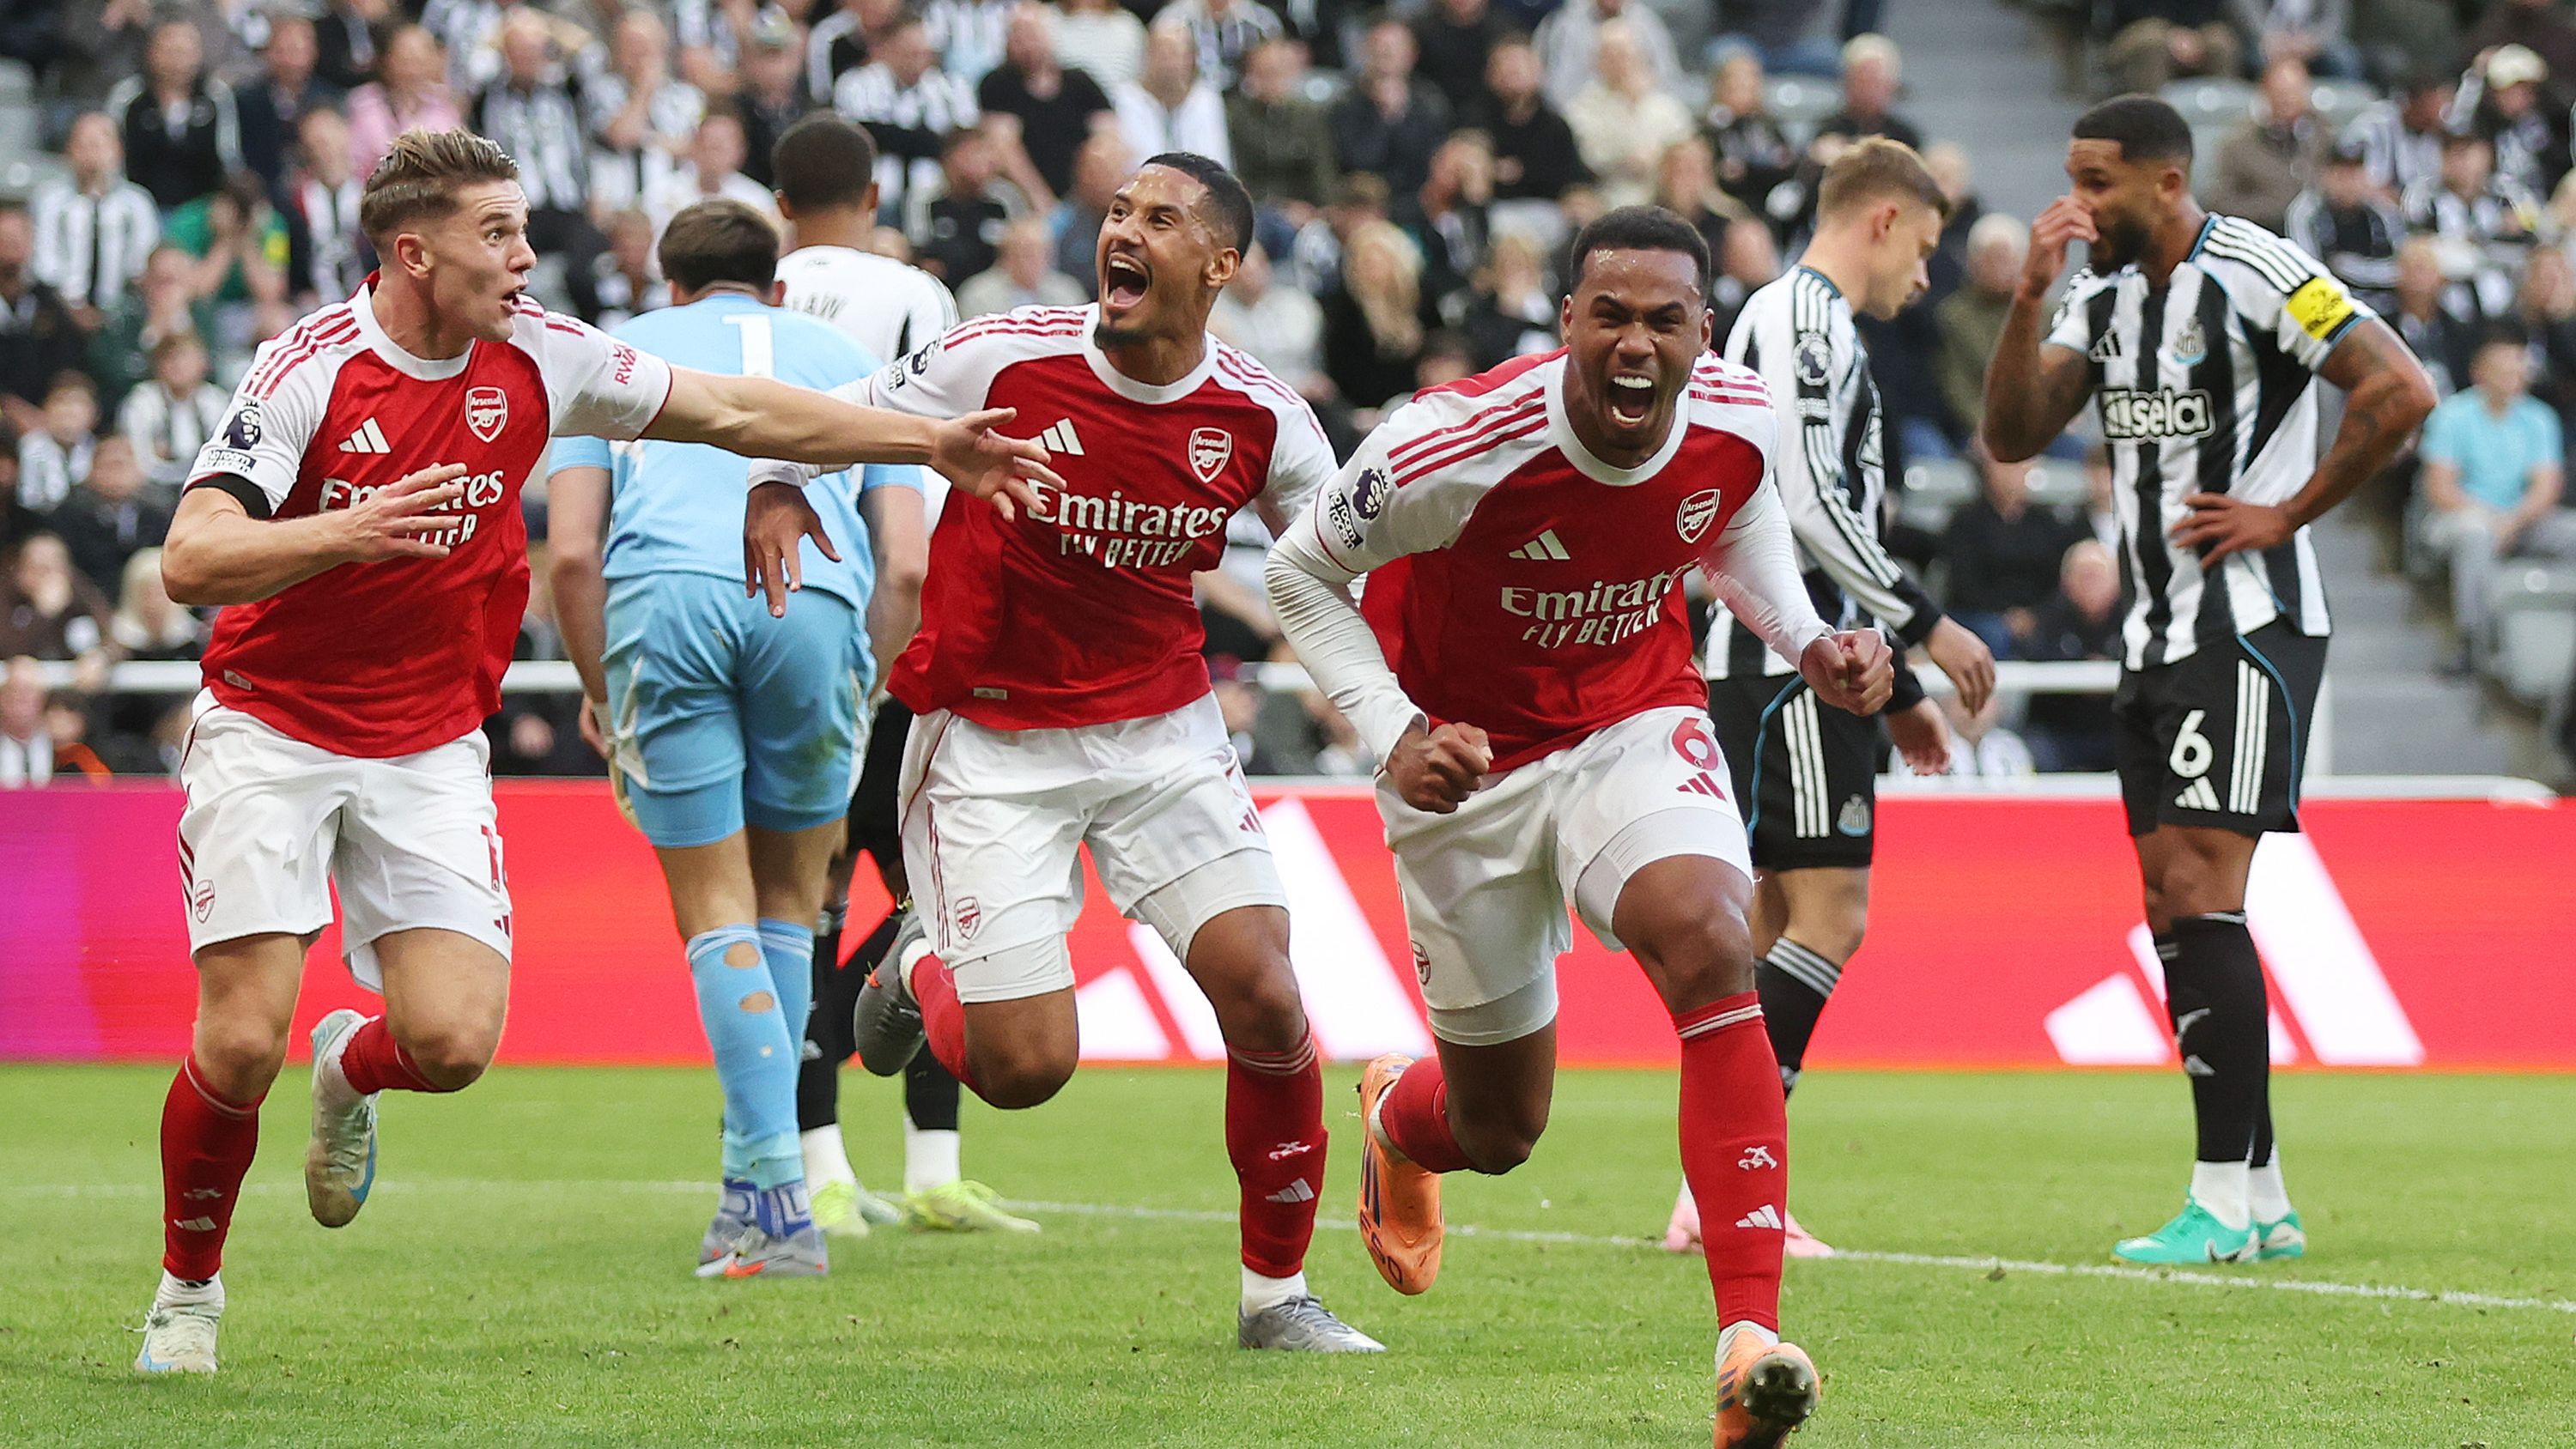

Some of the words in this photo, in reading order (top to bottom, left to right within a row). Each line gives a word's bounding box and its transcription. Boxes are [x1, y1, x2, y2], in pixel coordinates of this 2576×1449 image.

[720, 312, 776, 376] 1
[319, 470, 504, 513] Emtes
[1026, 478, 1228, 538] Emirates
[1685, 497, 1714, 512] Arsenal
[1337, 504, 1356, 542] room
[1104, 538, 1194, 568] BETTER
[1502, 557, 1699, 621] Emirat
[1522, 622, 1574, 649] FLY
[1575, 599, 1661, 646] BETTER
[1672, 717, 1718, 770] 6
[2169, 709, 2213, 778] 6
